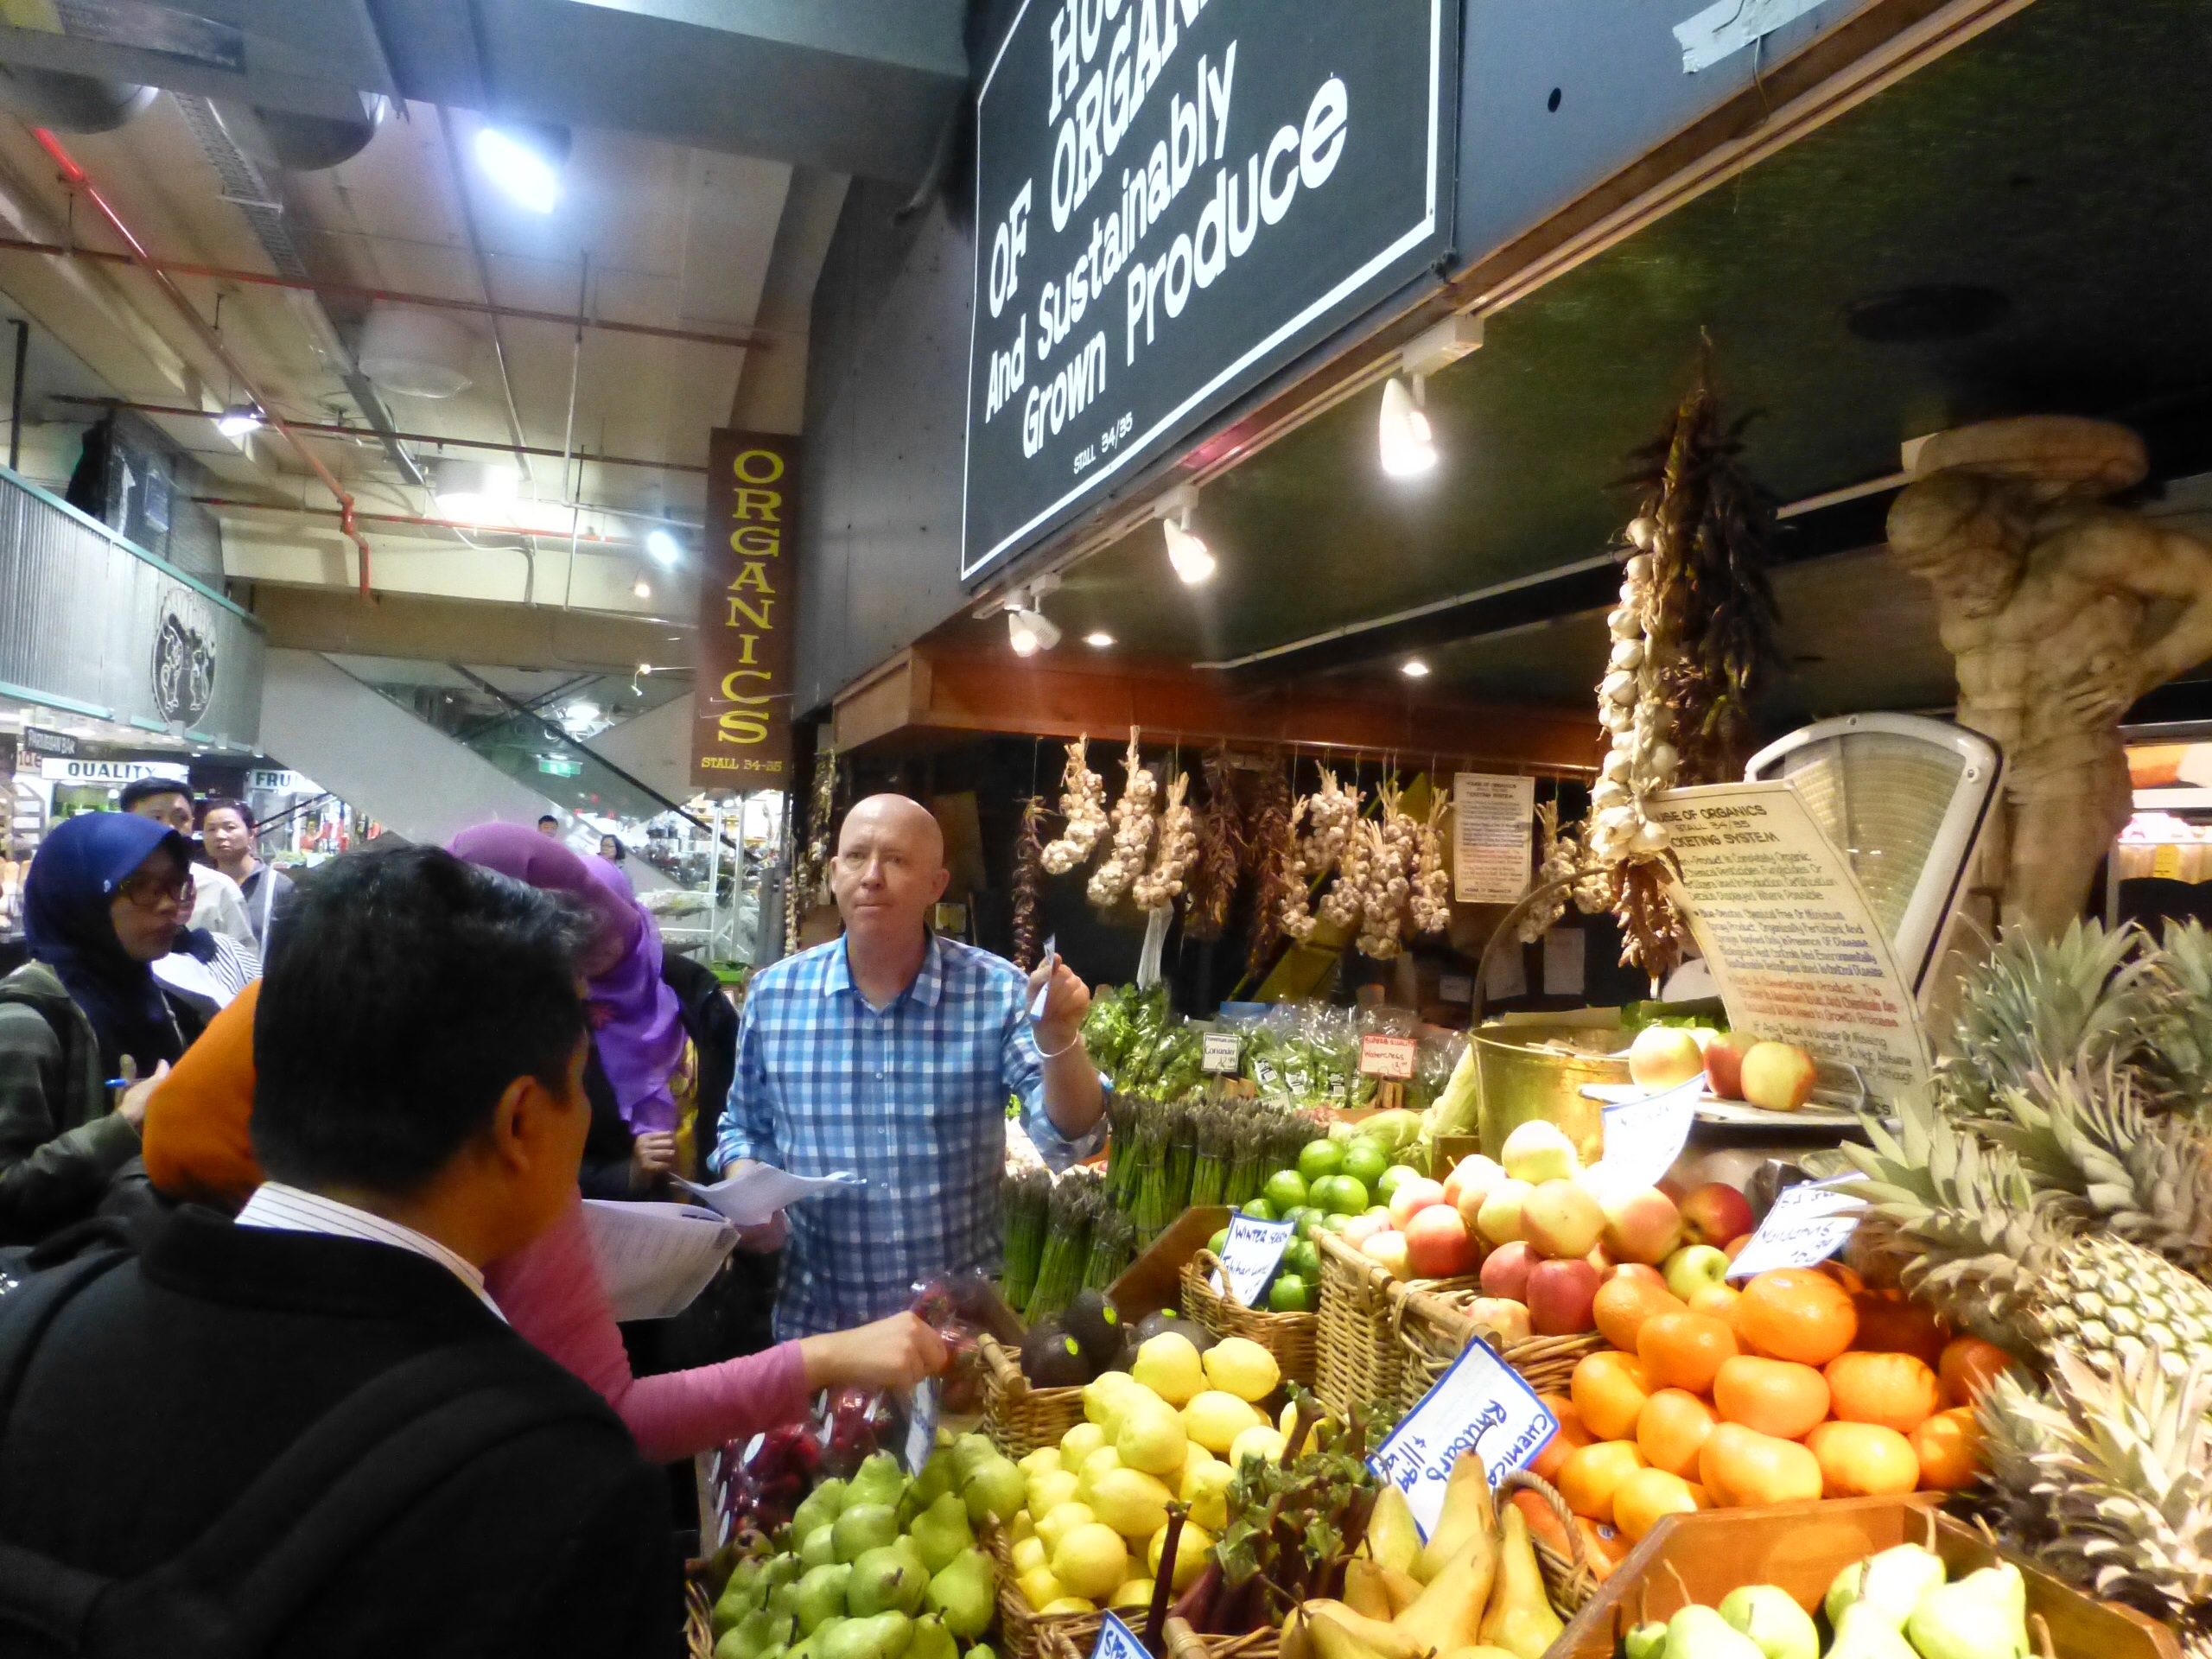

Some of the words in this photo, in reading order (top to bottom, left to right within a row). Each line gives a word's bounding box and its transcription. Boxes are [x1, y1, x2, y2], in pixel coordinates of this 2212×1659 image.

[1049, 0, 1122, 128] HO
[989, 177, 1032, 319] OF
[1051, 0, 1208, 232] ORGAN
[985, 313, 1027, 423] And
[1038, 40, 1236, 360] Sustainably
[1022, 330, 1106, 459] Grown
[1127, 78, 1348, 367] Produce
[1073, 445, 1096, 474] STALL
[1102, 411, 1133, 454] 34/35
[718, 448, 784, 744] ORGANICS
[68, 762, 156, 779] QUALITY
[256, 772, 298, 787] FRU
[702, 757, 739, 770] STALL
[744, 760, 782, 772] 34-35
[1670, 834, 1721, 849] CKETING
[1723, 831, 1780, 845] SYSTEM
[1675, 823, 1707, 832] STALL
[1682, 809, 1698, 821] OF
[1700, 804, 1767, 820] ORGANICS
[1426, 1398, 1508, 1483] Rhubarb
[1487, 1414, 1548, 1488] CHEMICA
